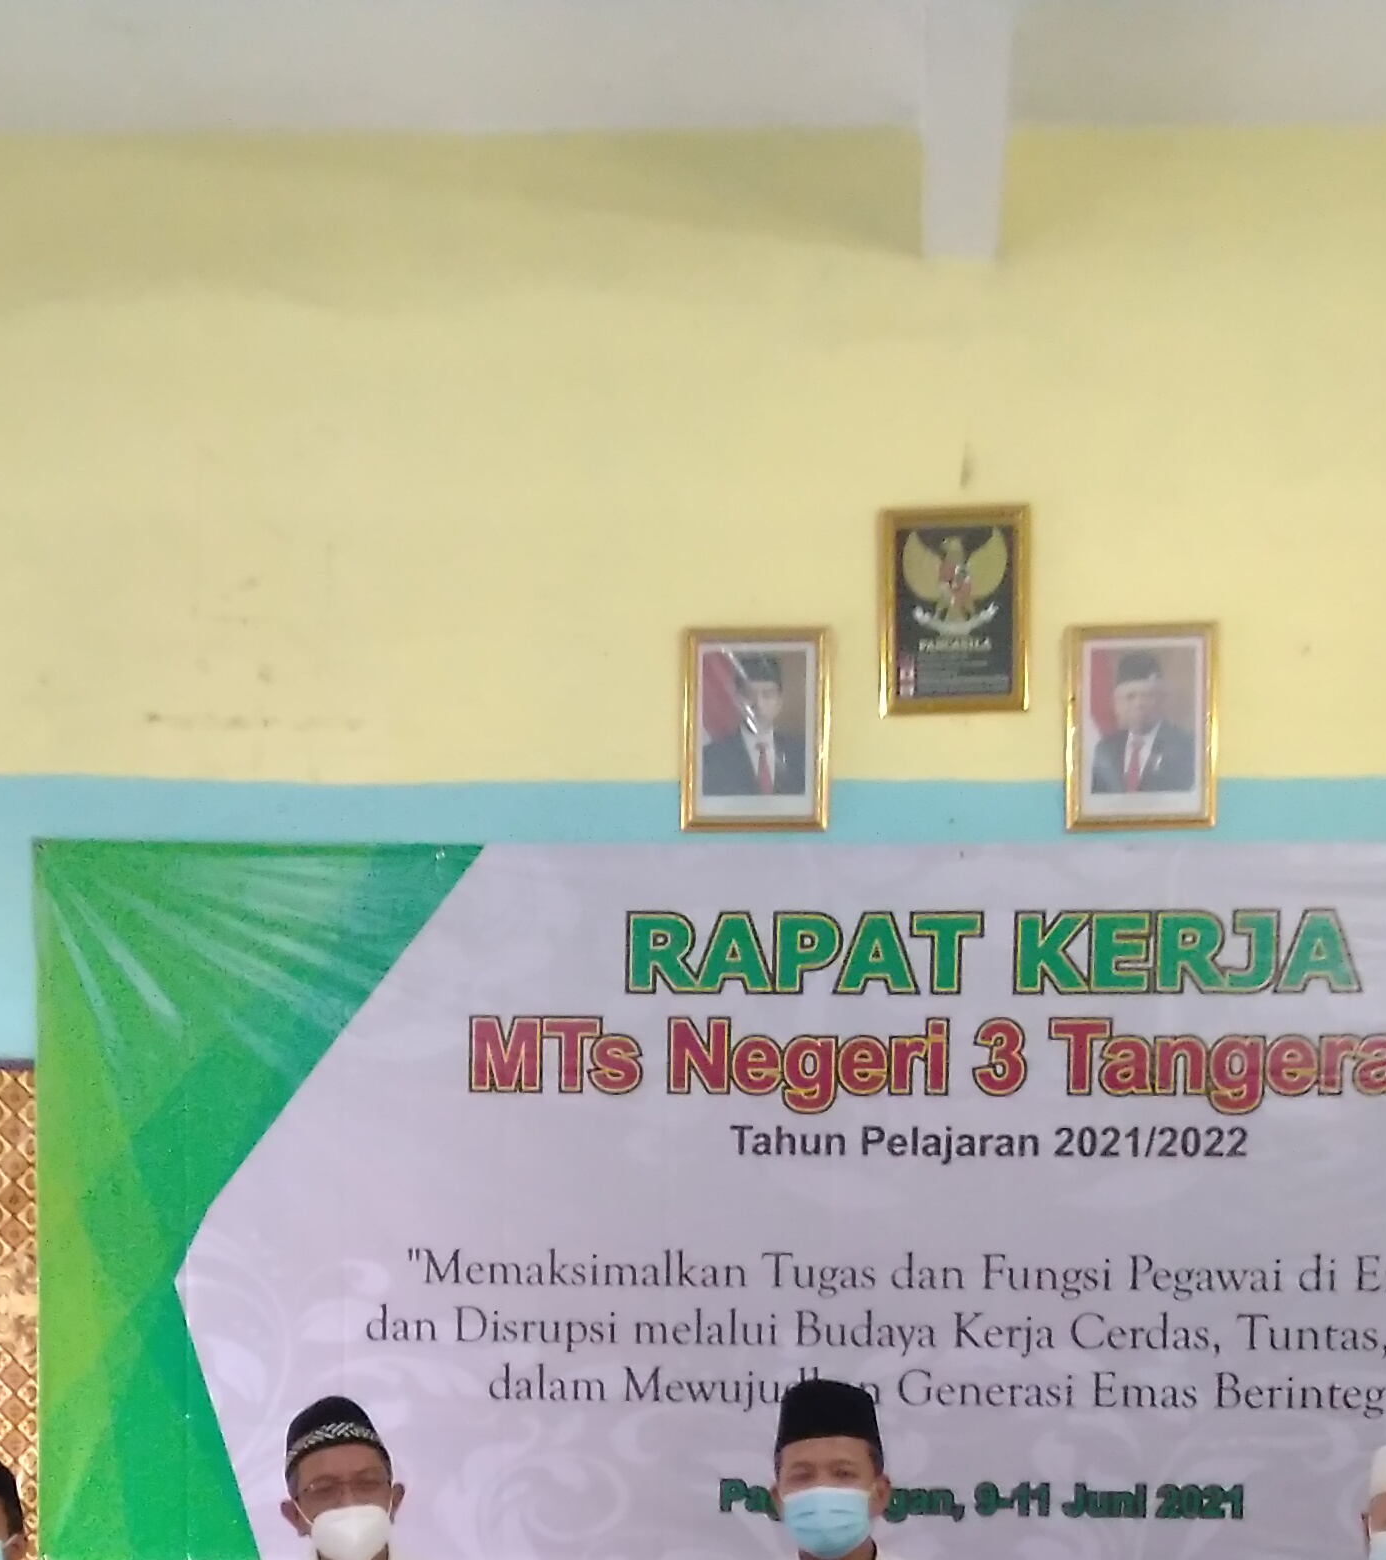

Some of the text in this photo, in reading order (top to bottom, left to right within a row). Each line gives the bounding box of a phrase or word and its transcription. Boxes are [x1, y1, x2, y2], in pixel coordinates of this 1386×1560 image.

[625, 909, 1363, 996] RAPAT KERJA
[469, 1015, 644, 1095] MTs
[667, 1016, 950, 1115] Negeri
[972, 1017, 1028, 1097] 3
[730, 1125, 1248, 1166] Tahun Pelajaran 2021/2022
[408, 1248, 748, 1288] "Memaksimalkan
[761, 1251, 876, 1299] Tugas
[891, 1251, 965, 1290] dan
[983, 1253, 1111, 1301] Fungsi
[1130, 1255, 1283, 1301] Pegawai
[1299, 1252, 1337, 1293] di
[366, 1303, 437, 1342] dan
[455, 1306, 620, 1353] Disrupsi
[635, 1308, 777, 1346] melalui
[795, 1309, 936, 1357] Budaya
[954, 1311, 1055, 1358] Kerja
[1070, 1311, 1220, 1358] Cerdas,
[489, 1362, 607, 1402] dalam
[624, 1366, 882, 1411] Mewujudn
[897, 1369, 1075, 1409] Generasi
[1093, 1371, 1197, 1409] Emas
[974, 1480, 1050, 1517] 9-11
[1061, 1481, 1147, 1519] Juni
[1154, 1483, 1244, 1519] 2021
